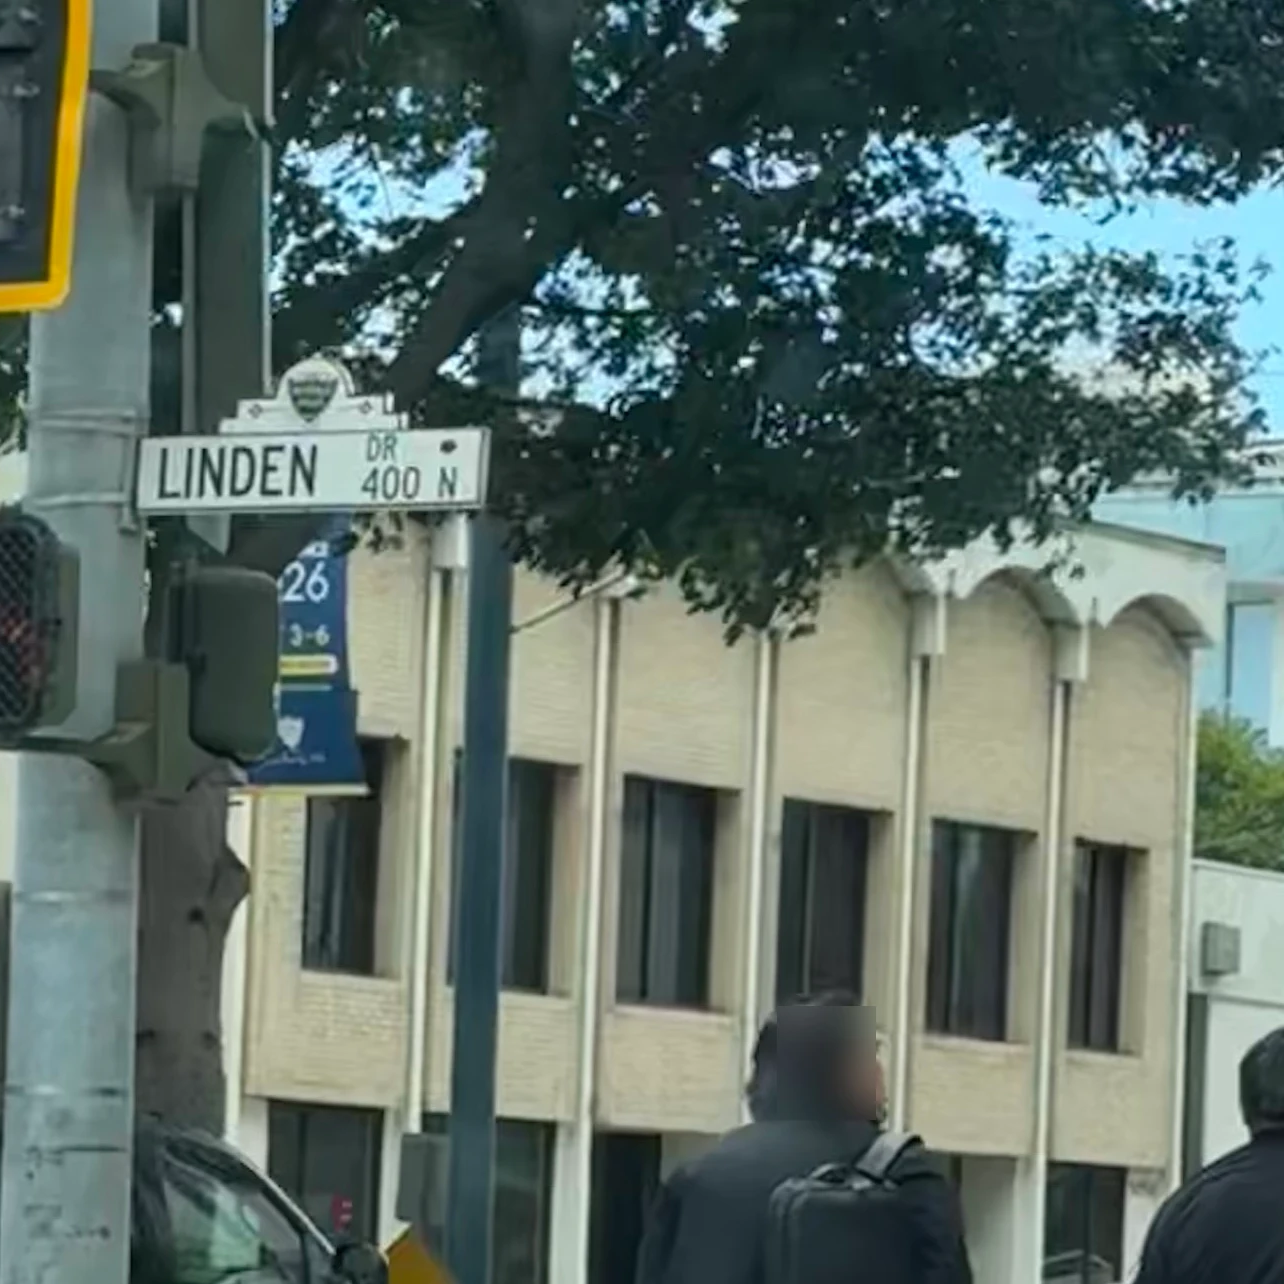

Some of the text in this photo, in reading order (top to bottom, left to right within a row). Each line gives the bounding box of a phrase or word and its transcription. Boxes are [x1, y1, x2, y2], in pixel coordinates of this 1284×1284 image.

[366, 434, 398, 462] DR
[158, 444, 318, 500] LINDEN
[361, 465, 457, 500] 400 N
